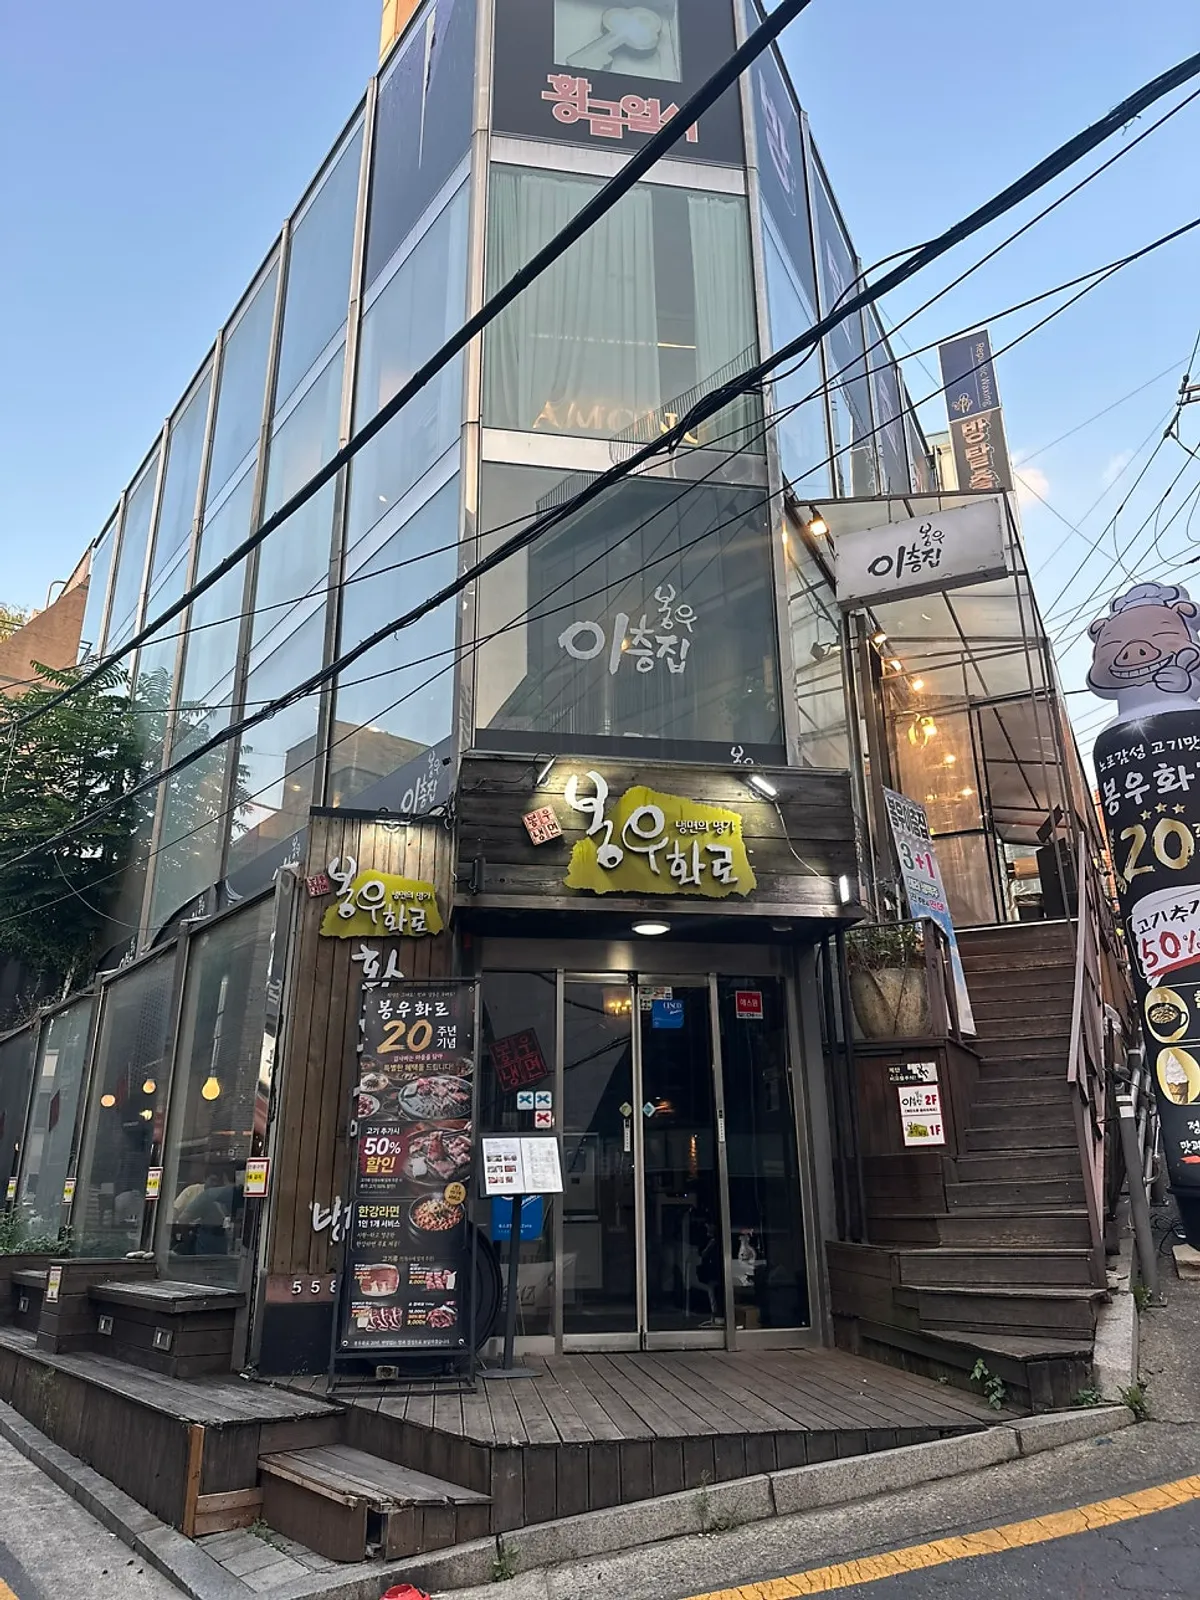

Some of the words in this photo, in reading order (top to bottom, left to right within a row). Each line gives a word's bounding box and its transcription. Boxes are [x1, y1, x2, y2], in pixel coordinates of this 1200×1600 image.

[920, 522, 945, 545] 봉우
[868, 544, 941, 578] 이층집
[655, 584, 697, 633] 봉우
[558, 612, 690, 675] 이층집
[1098, 743, 1146, 773] 노포감성
[400, 773, 437, 813] 이층집
[1103, 762, 1200, 816] 봉우화
[675, 820, 710, 834] 냉면의
[713, 820, 736, 834] 명가
[1120, 817, 1195, 884] 20
[378, 1000, 449, 1020] 봉우화로
[376, 1019, 433, 1053] 20
[436, 1025, 457, 1037] 주년
[436, 1038, 457, 1049] 기념
[925, 1094, 937, 1105] 2F
[366, 1127, 380, 1135] 고기
[929, 1125, 941, 1136] 1F
[364, 1137, 402, 1155] 50%
[366, 1156, 396, 1173] 할인
[358, 1205, 400, 1218] 한강라면
